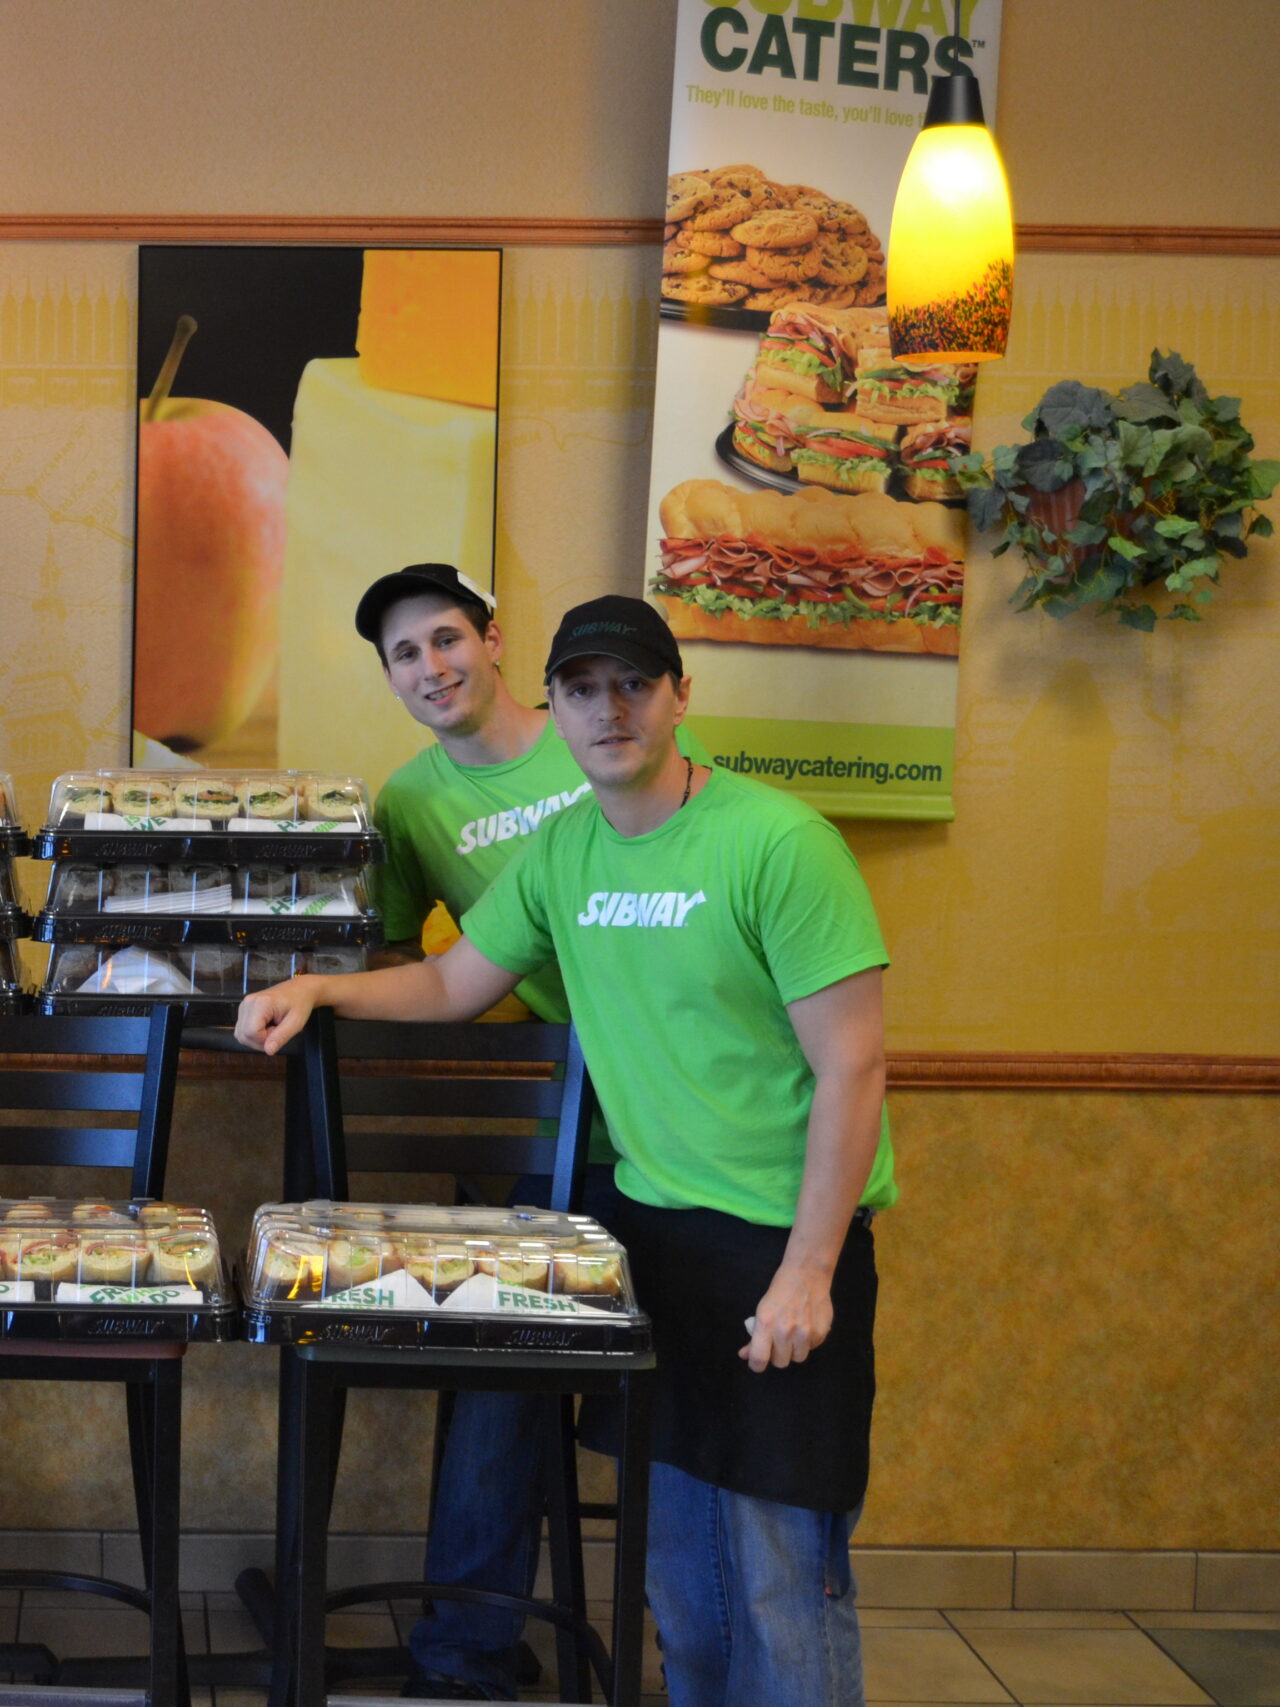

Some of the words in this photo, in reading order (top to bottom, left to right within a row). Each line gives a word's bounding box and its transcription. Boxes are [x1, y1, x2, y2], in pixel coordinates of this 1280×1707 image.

[701, 6, 974, 95] CATERS
[686, 84, 735, 108] They'll
[738, 90, 769, 111] love
[773, 95, 795, 113] the
[800, 98, 839, 121] taste,
[843, 105, 882, 124] you'll
[885, 111, 914, 128] love
[713, 751, 943, 785] subwaycatering.com
[578, 889, 707, 928] SUBWAY
[325, 1287, 394, 1308] RESH
[497, 1290, 576, 1312] FRESH
